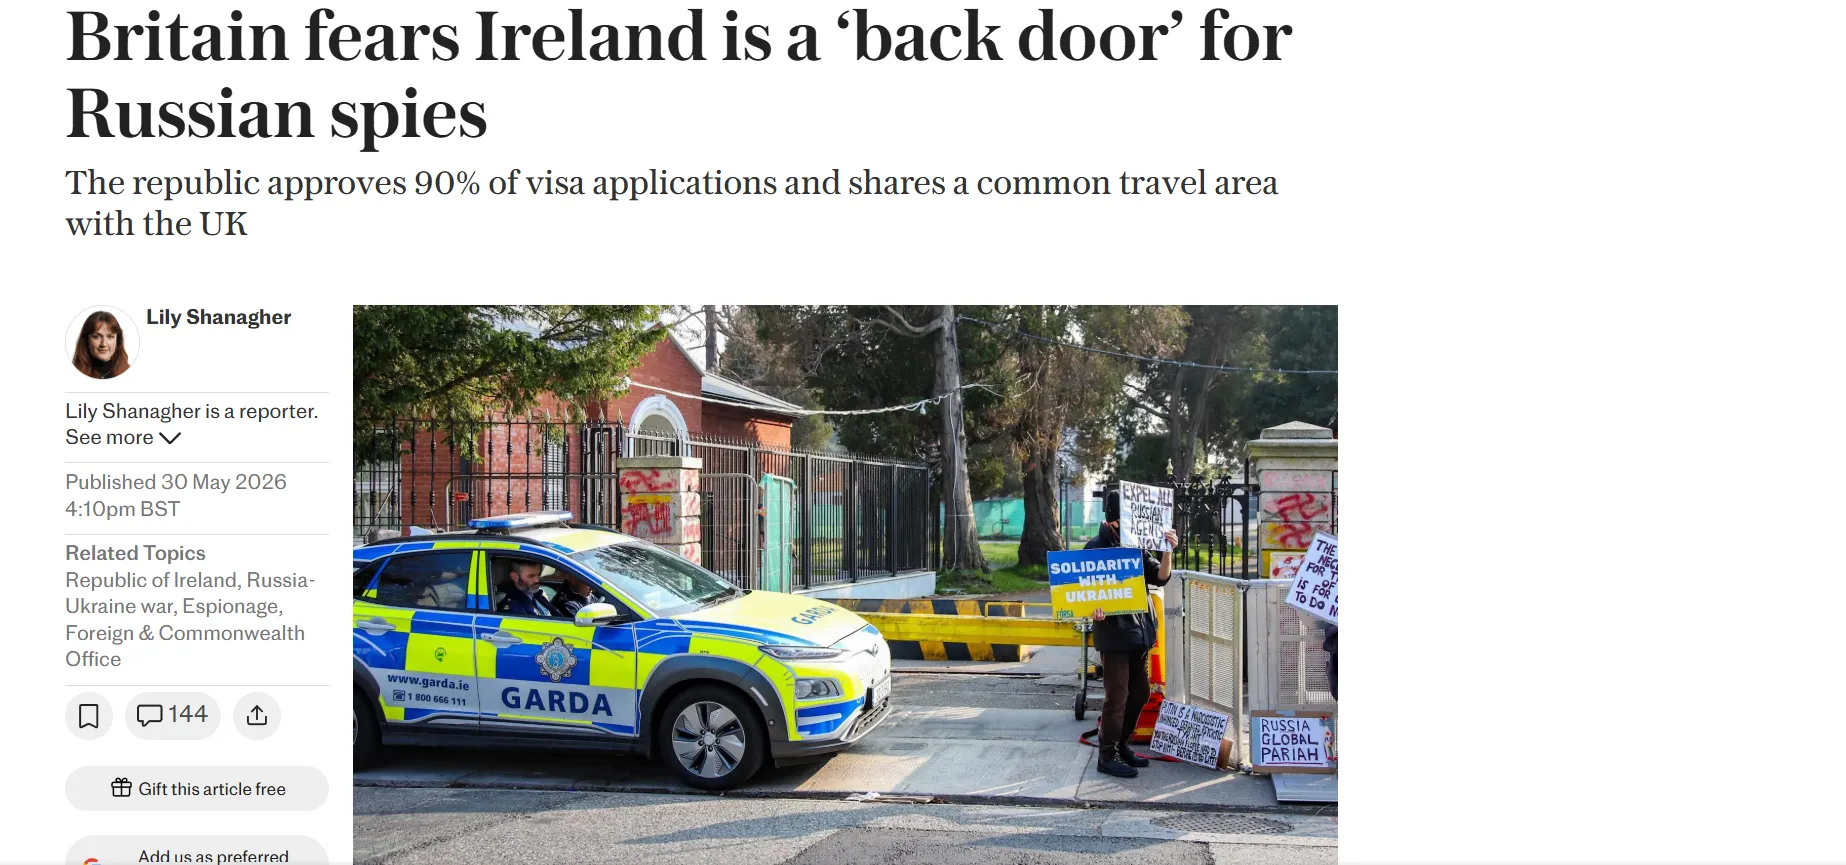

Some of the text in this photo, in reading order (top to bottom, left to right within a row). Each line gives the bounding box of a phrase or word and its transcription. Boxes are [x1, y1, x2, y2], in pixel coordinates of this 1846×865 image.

[66, 10, 290, 61] Britain
[305, 8, 459, 61] fears
[475, 9, 707, 61] Ireland
[722, 10, 771, 61] is
[787, 25, 822, 61] a
[1200, 8, 1293, 61] for
[66, 87, 487, 152] Russian spies
[65, 169, 1279, 201] The republic approves 90% of visa applications and shares a common travel area
[65, 210, 248, 236] with the UK
[147, 309, 291, 329] Lily Shanagher
[66, 403, 318, 423] Lily Shanagher is a reporter.
[66, 429, 153, 444] See more
[66, 474, 286, 493] Published 30 May 2026
[1122, 483, 1172, 507] EXPEL ALL
[66, 501, 180, 520] 4:10pm BST
[1130, 518, 1164, 539] AGENTS
[66, 545, 205, 564] Related Topics
[1316, 539, 1337, 556] THE
[1050, 558, 1141, 575] SOLIDARITY
[1306, 562, 1325, 577] FOR
[66, 572, 315, 591] Republic of Ireland, Russia-
[1079, 573, 1117, 587] WITH
[1322, 580, 1337, 590] OF
[1065, 588, 1133, 603] UKRAINE
[1295, 591, 1307, 603] TO
[1309, 596, 1325, 610] DO
[1312, 584, 1331, 600] FOR
[66, 598, 282, 618] Ukraine war, Espionage,
[791, 605, 839, 624] GARDA
[66, 625, 304, 645] Foreign & Commonwealth
[66, 651, 121, 666] Office
[387, 674, 470, 691] www.garda.ie
[407, 692, 466, 706] 1 800 666 111
[501, 686, 613, 717] GARDA
[169, 705, 208, 722] 144
[1261, 718, 1310, 732] RUSSIA
[1262, 733, 1319, 745] GLOBAL
[139, 782, 286, 795] Gift this article free
[138, 850, 288, 865] Add us as preferred
